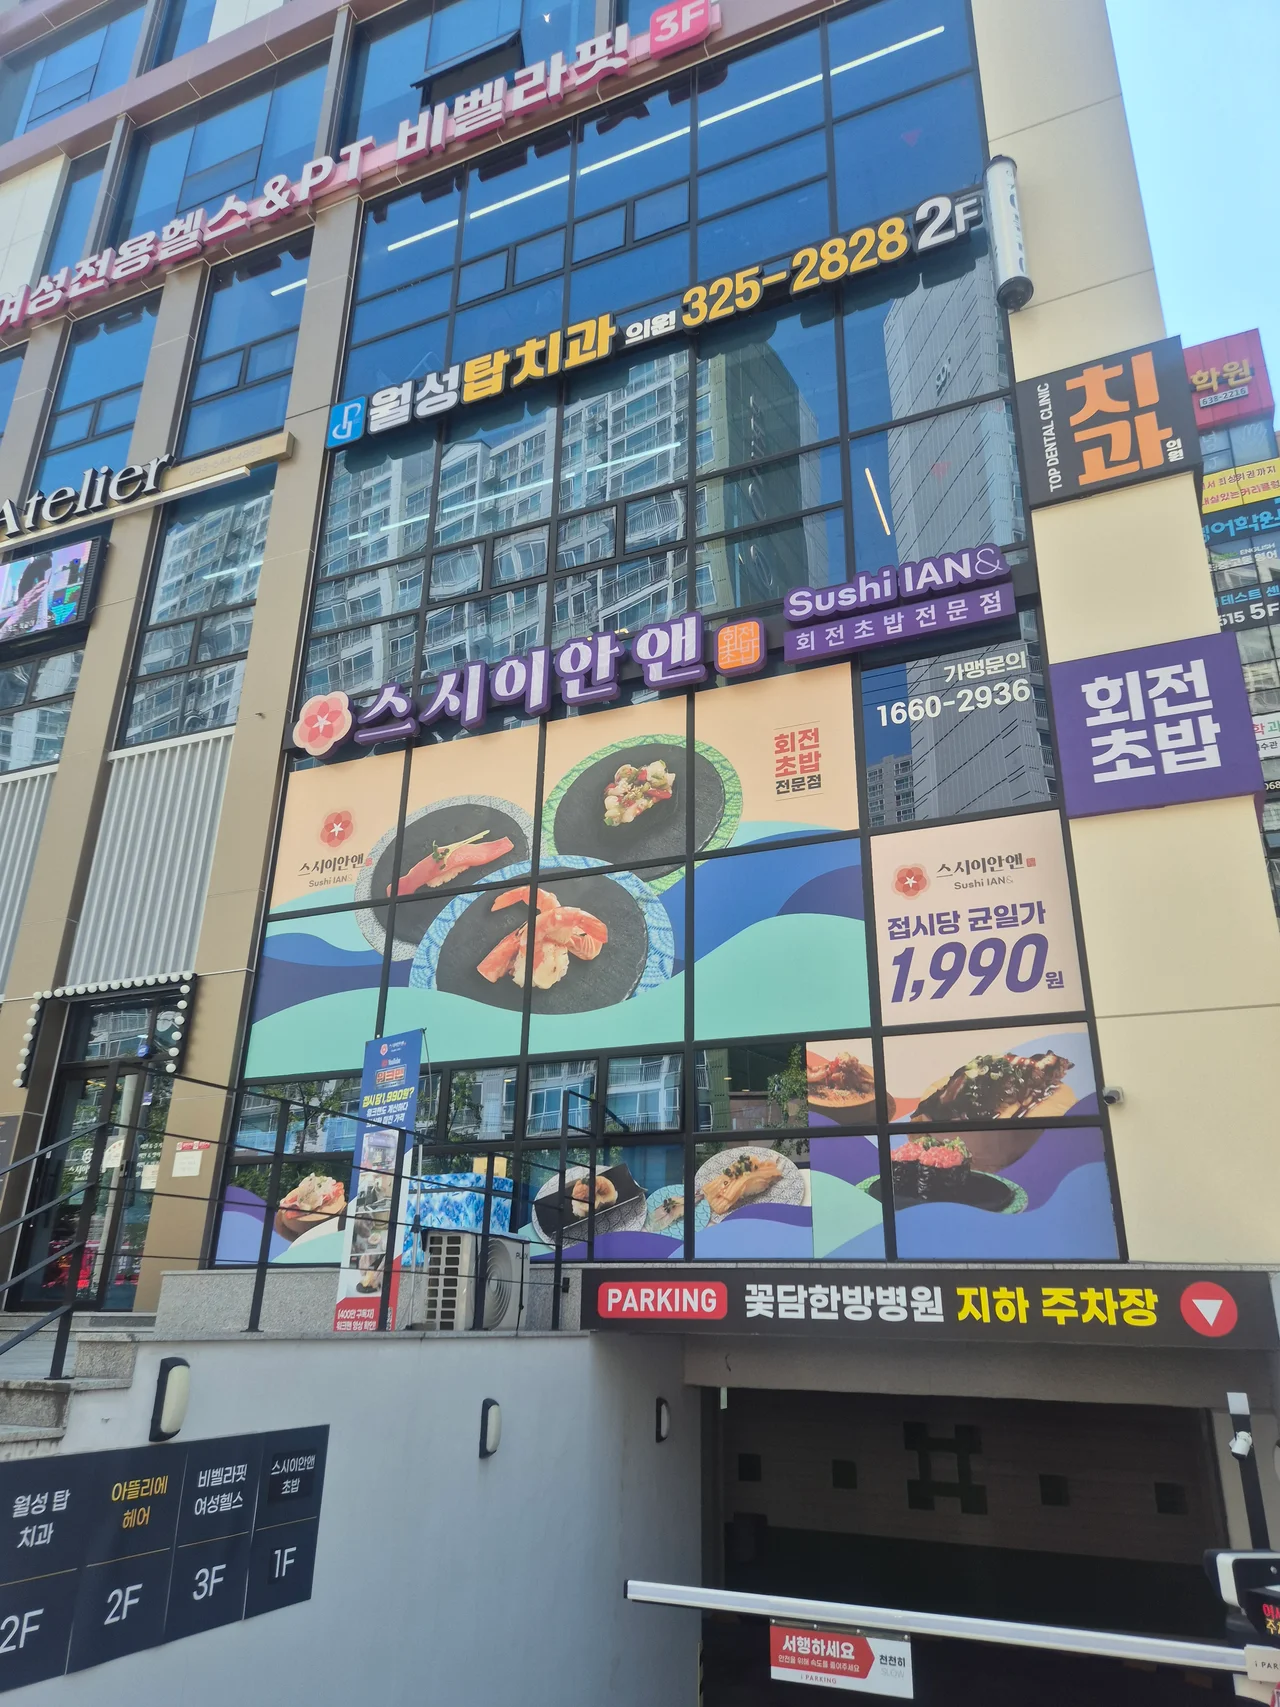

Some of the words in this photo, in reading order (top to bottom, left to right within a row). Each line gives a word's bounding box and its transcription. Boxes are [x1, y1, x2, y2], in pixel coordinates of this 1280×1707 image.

[396, 23, 630, 162] 비벨라핏
[653, 2, 707, 43] 3F
[682, 216, 910, 329] 325-2828
[914, 195, 982, 251] 2F
[1190, 359, 1253, 392] 학원
[1037, 382, 1054, 421] CLINIC
[1042, 420, 1060, 466] DENTAL
[1047, 467, 1062, 493] TOP
[788, 570, 892, 617] Sushi
[1249, 601, 1280, 620] 5F
[356, 613, 704, 739] 스시이안앤
[943, 650, 1028, 684] 가맹문의
[876, 680, 1031, 727] 1660-2936
[1081, 659, 1213, 729] 회전
[774, 727, 820, 756] 회전
[1091, 715, 1223, 784] 초밥
[774, 750, 822, 779] 초밥
[775, 774, 823, 796] 전문점
[297, 853, 365, 877] 스시이안앤
[935, 853, 1025, 878] 스시이안앤
[308, 877, 332, 888] Sushi
[953, 879, 984, 890] Sushi
[887, 911, 961, 940] 접시당
[967, 900, 1046, 932] 균일가
[607, 1287, 717, 1314] PARKING
[744, 1284, 945, 1323] 꽃담한방병원
[956, 1286, 1030, 1326] 지하
[1041, 1287, 1159, 1327] 주차장
[198, 1464, 248, 1488] 비벨라핏
[270, 1455, 316, 1476] 스시이안앤
[111, 1475, 169, 1502] 아뜰리에
[281, 1478, 301, 1495] 초밥
[13, 1492, 49, 1519] 월성
[52, 1489, 71, 1512] 탑
[122, 1506, 151, 1529] 헤어
[194, 1491, 244, 1516] 여성헬스
[17, 1522, 54, 1549] 치과
[274, 1547, 297, 1579] 1F
[193, 1564, 227, 1601] 3F
[104, 1583, 143, 1626] 2F
[0, 1608, 44, 1654] 2F
[782, 1634, 856, 1660] 서행하세요
[879, 1654, 906, 1668] 천천히
[805, 1674, 837, 1685] PARKING
[881, 1668, 905, 1679] SLOW
